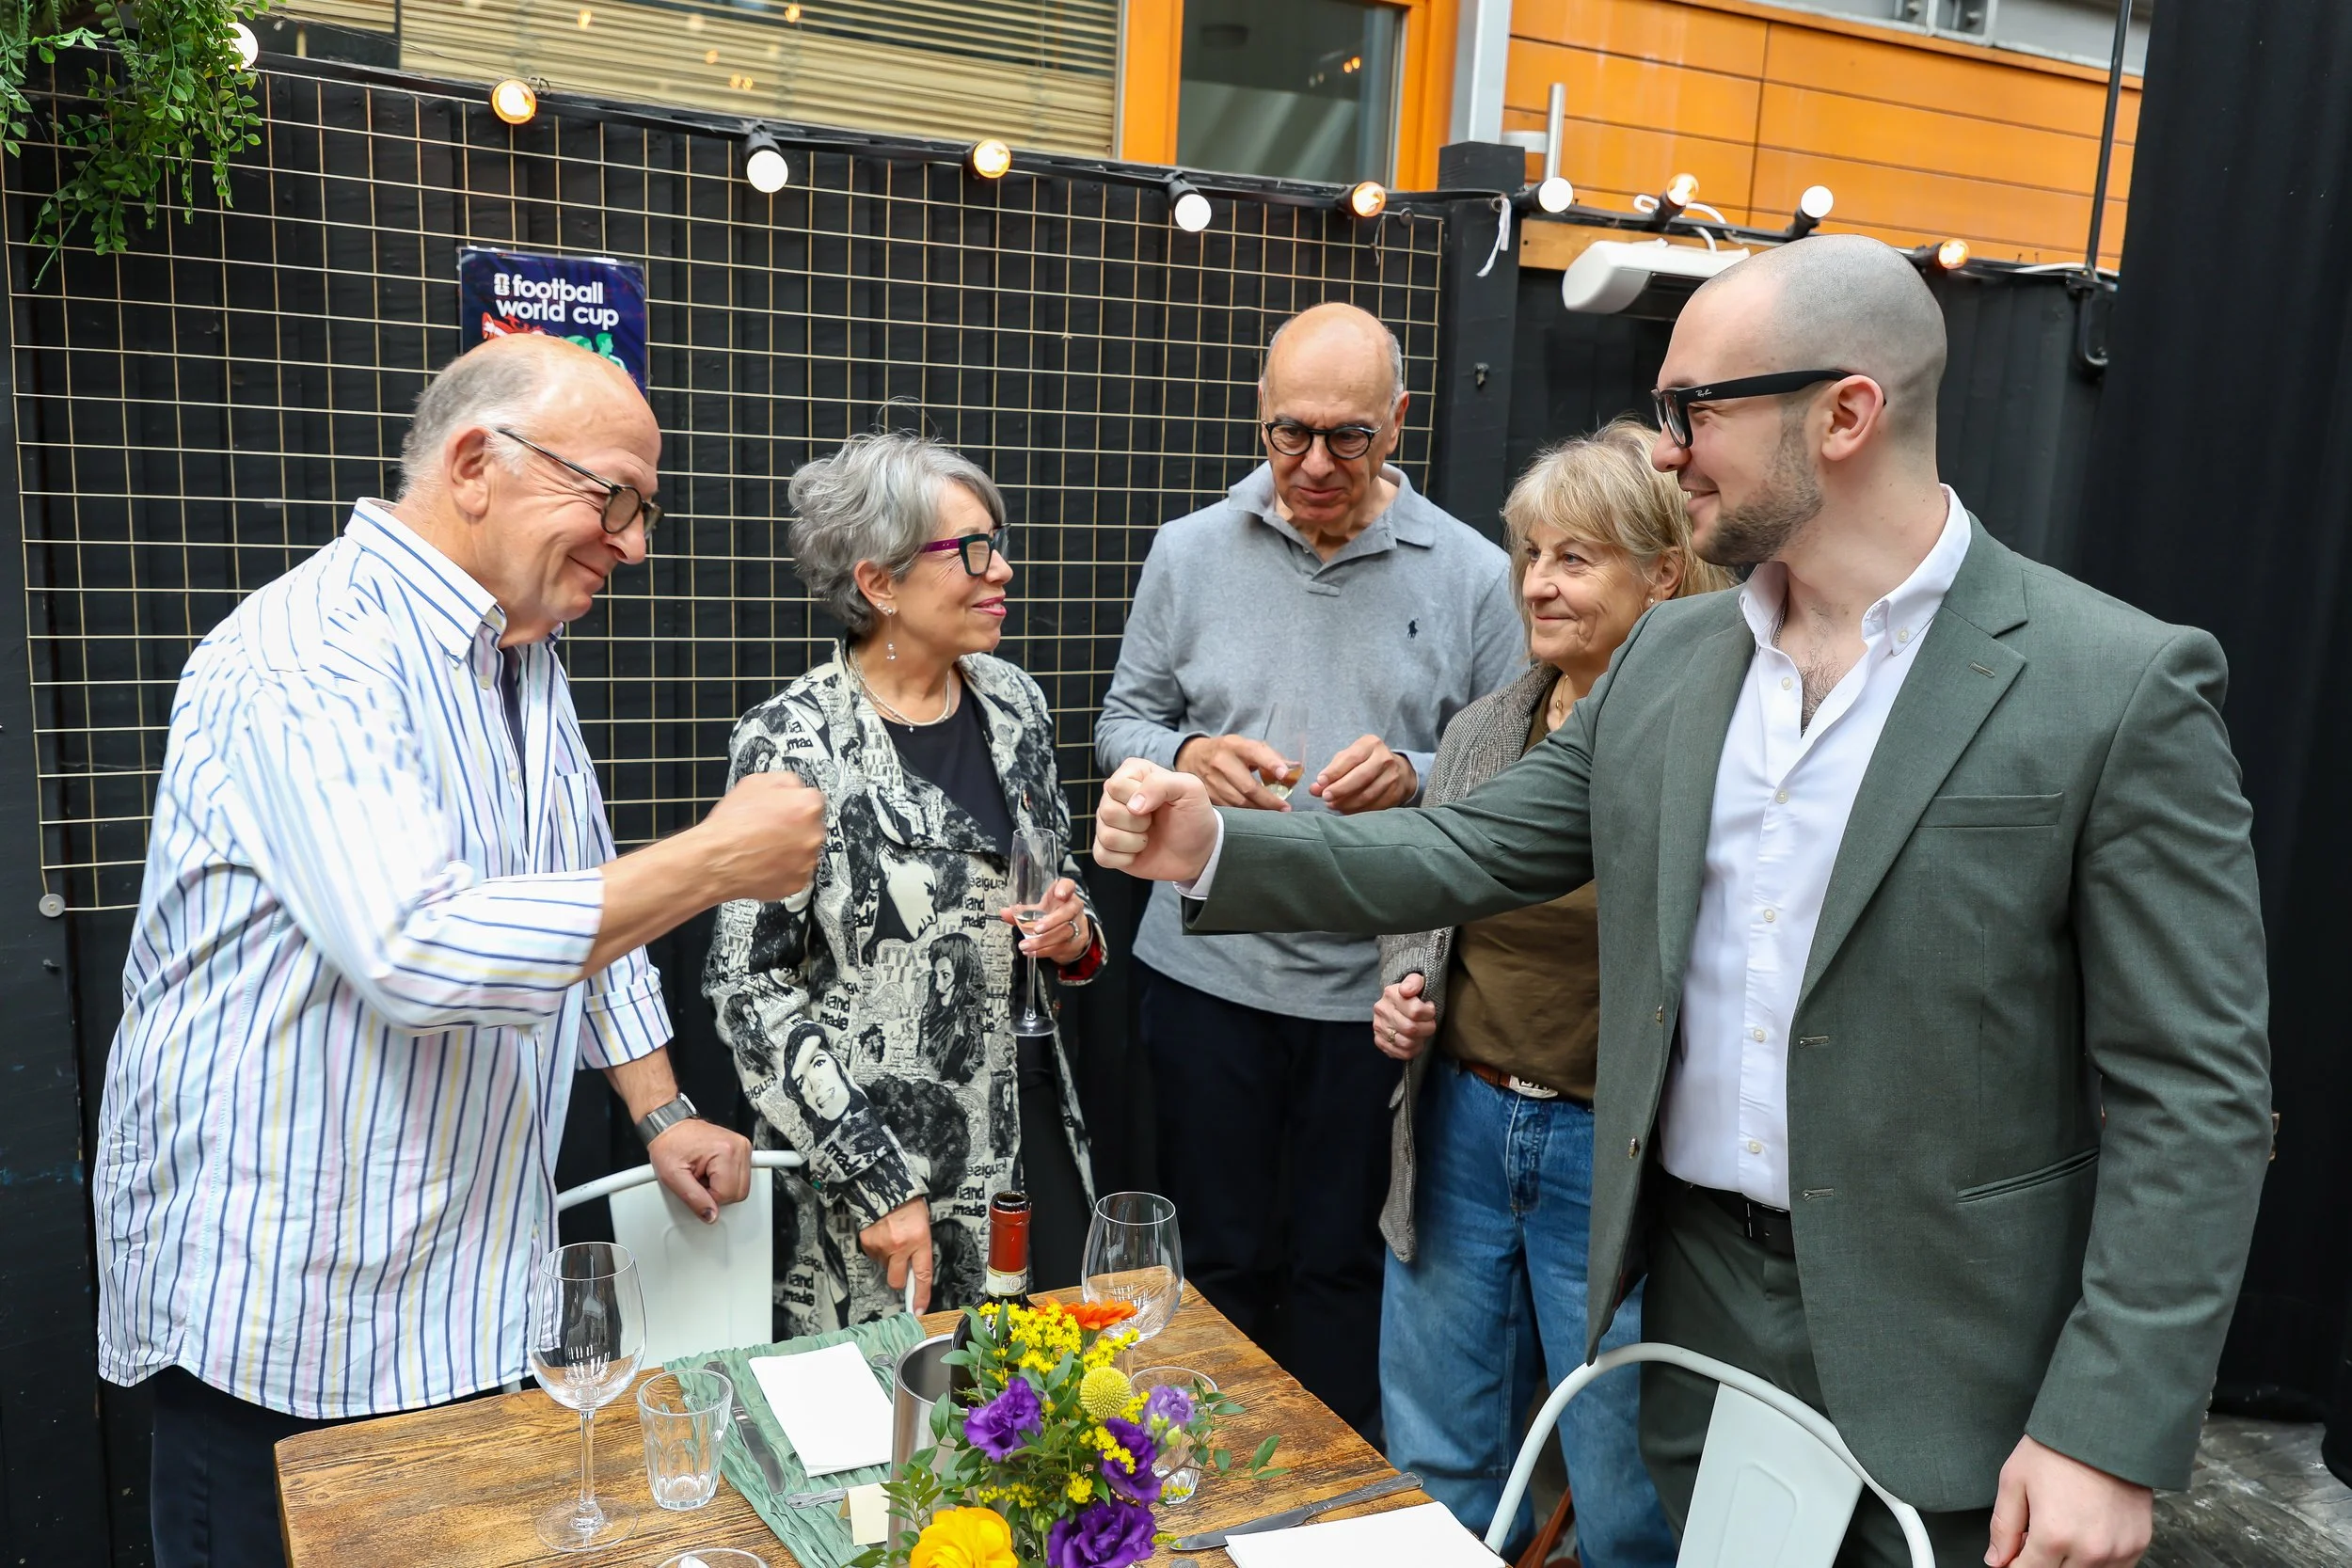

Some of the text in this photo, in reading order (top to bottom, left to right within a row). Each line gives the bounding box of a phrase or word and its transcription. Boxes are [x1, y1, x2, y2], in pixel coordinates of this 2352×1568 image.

[512, 274, 603, 304] football
[496, 297, 619, 330] world cup
[961, 912, 986, 929] made
[952, 1200, 986, 1217] made
